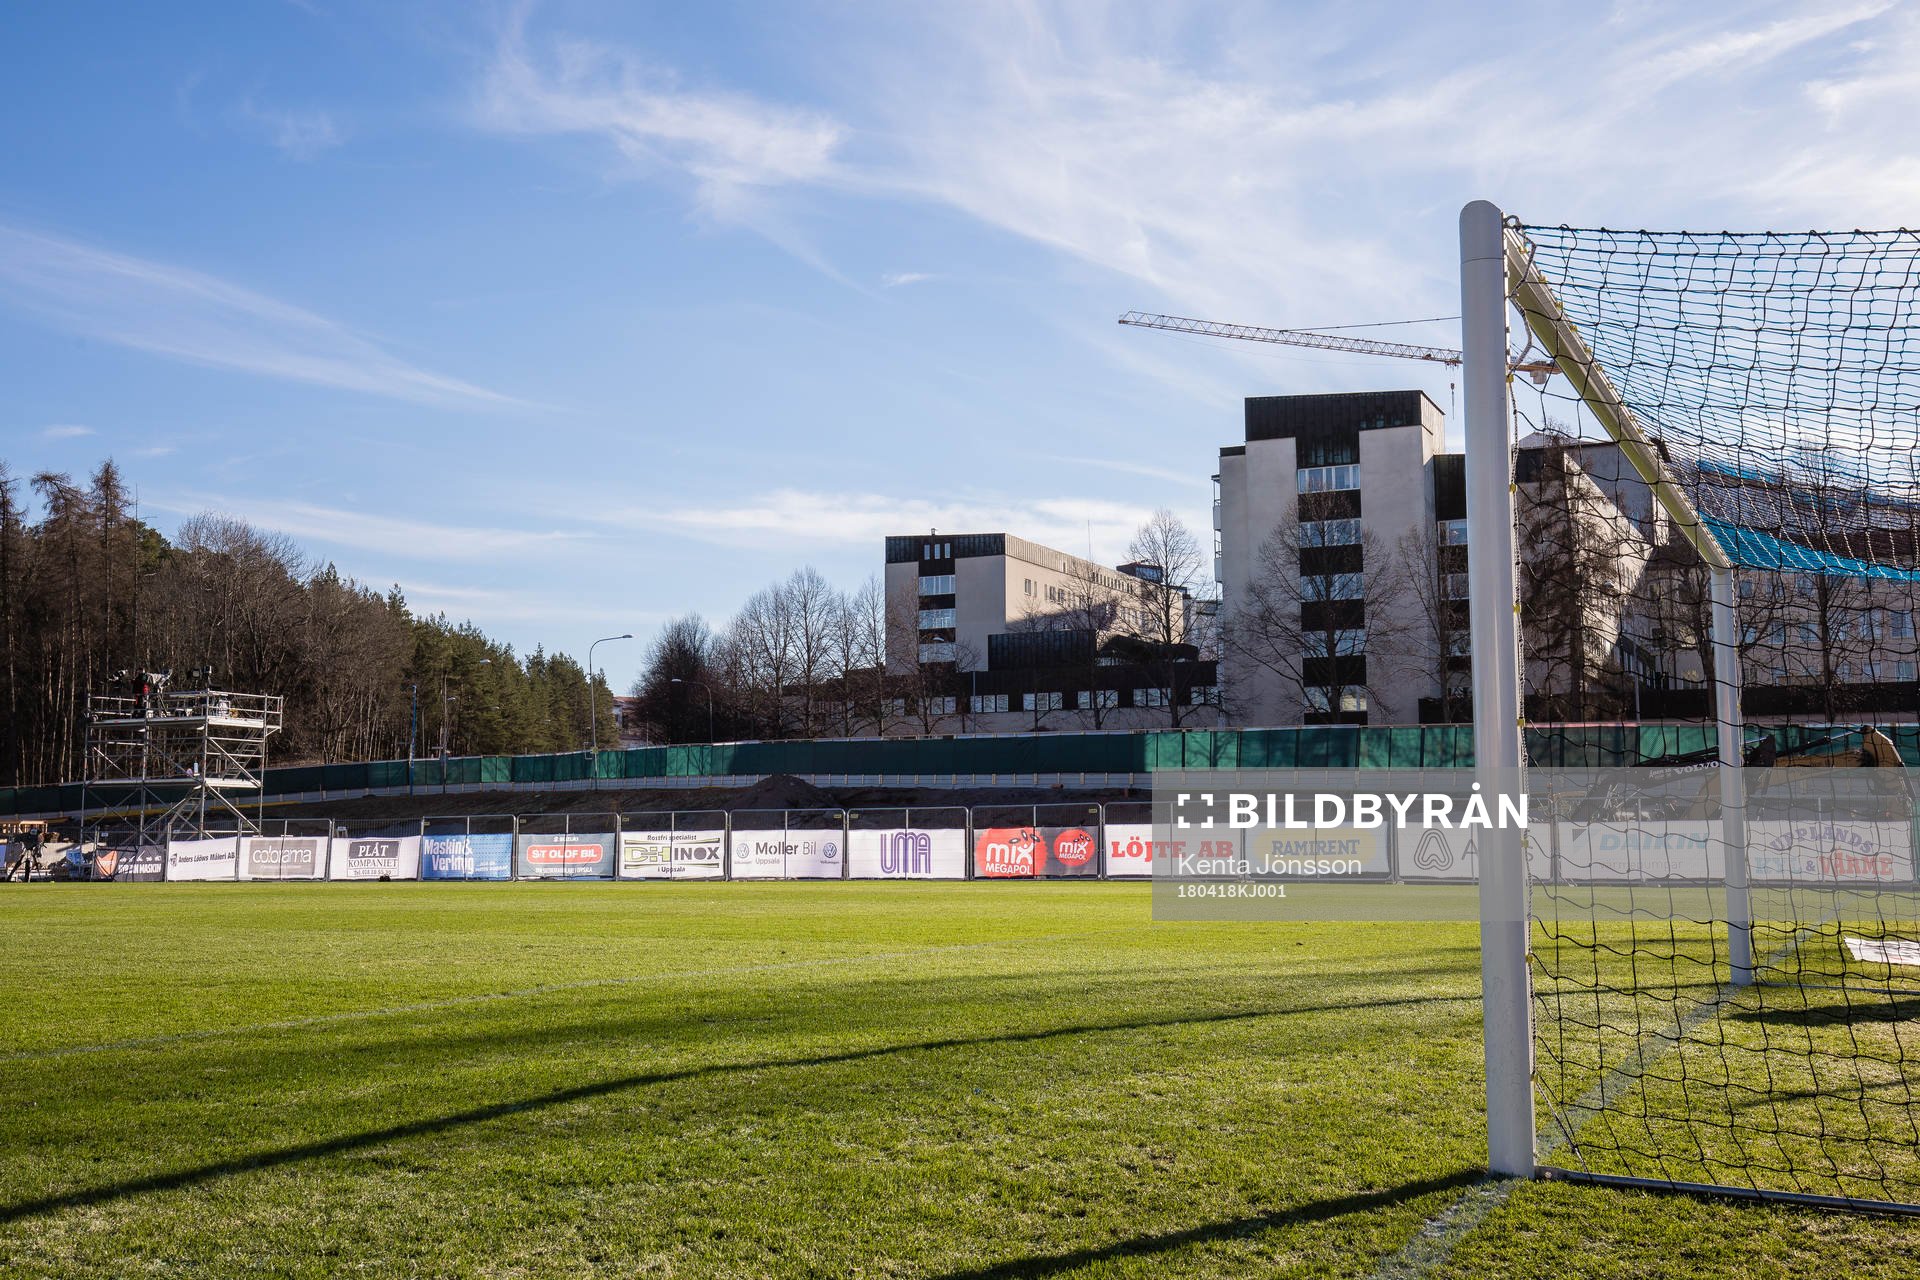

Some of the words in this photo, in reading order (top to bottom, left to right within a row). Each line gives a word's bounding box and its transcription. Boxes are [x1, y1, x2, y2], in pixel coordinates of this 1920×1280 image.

[1673, 760, 1719, 775] VOLVO
[647, 834, 668, 842] Rostfri
[669, 834, 697, 843] specialist
[1600, 832, 1709, 851] DAIKIN
[1769, 826, 1873, 854] UPPLANDS
[252, 845, 312, 864] colorama
[358, 842, 389, 858] PLÅT
[549, 848, 578, 859] OLOF
[581, 848, 597, 858] BIL
[674, 846, 720, 861] INOX
[802, 841, 816, 856] Bil
[880, 831, 931, 874] UMA
[986, 842, 1034, 865] mix
[1059, 840, 1087, 855] mix
[1111, 836, 1186, 862] LÖJTE
[1197, 840, 1234, 858] AB
[1271, 839, 1360, 856] RAMIRENT
[209, 853, 227, 862] Måleri
[227, 852, 235, 860] AB
[349, 858, 398, 868] KOMPANIET
[755, 857, 780, 866] Uppsala
[1058, 852, 1087, 861] MEGAPOL
[140, 863, 162, 874] MASKIN
[661, 866, 686, 874] Uppsala
[985, 862, 1032, 875] MEGAPOL
[1806, 860, 1816, 872] &
